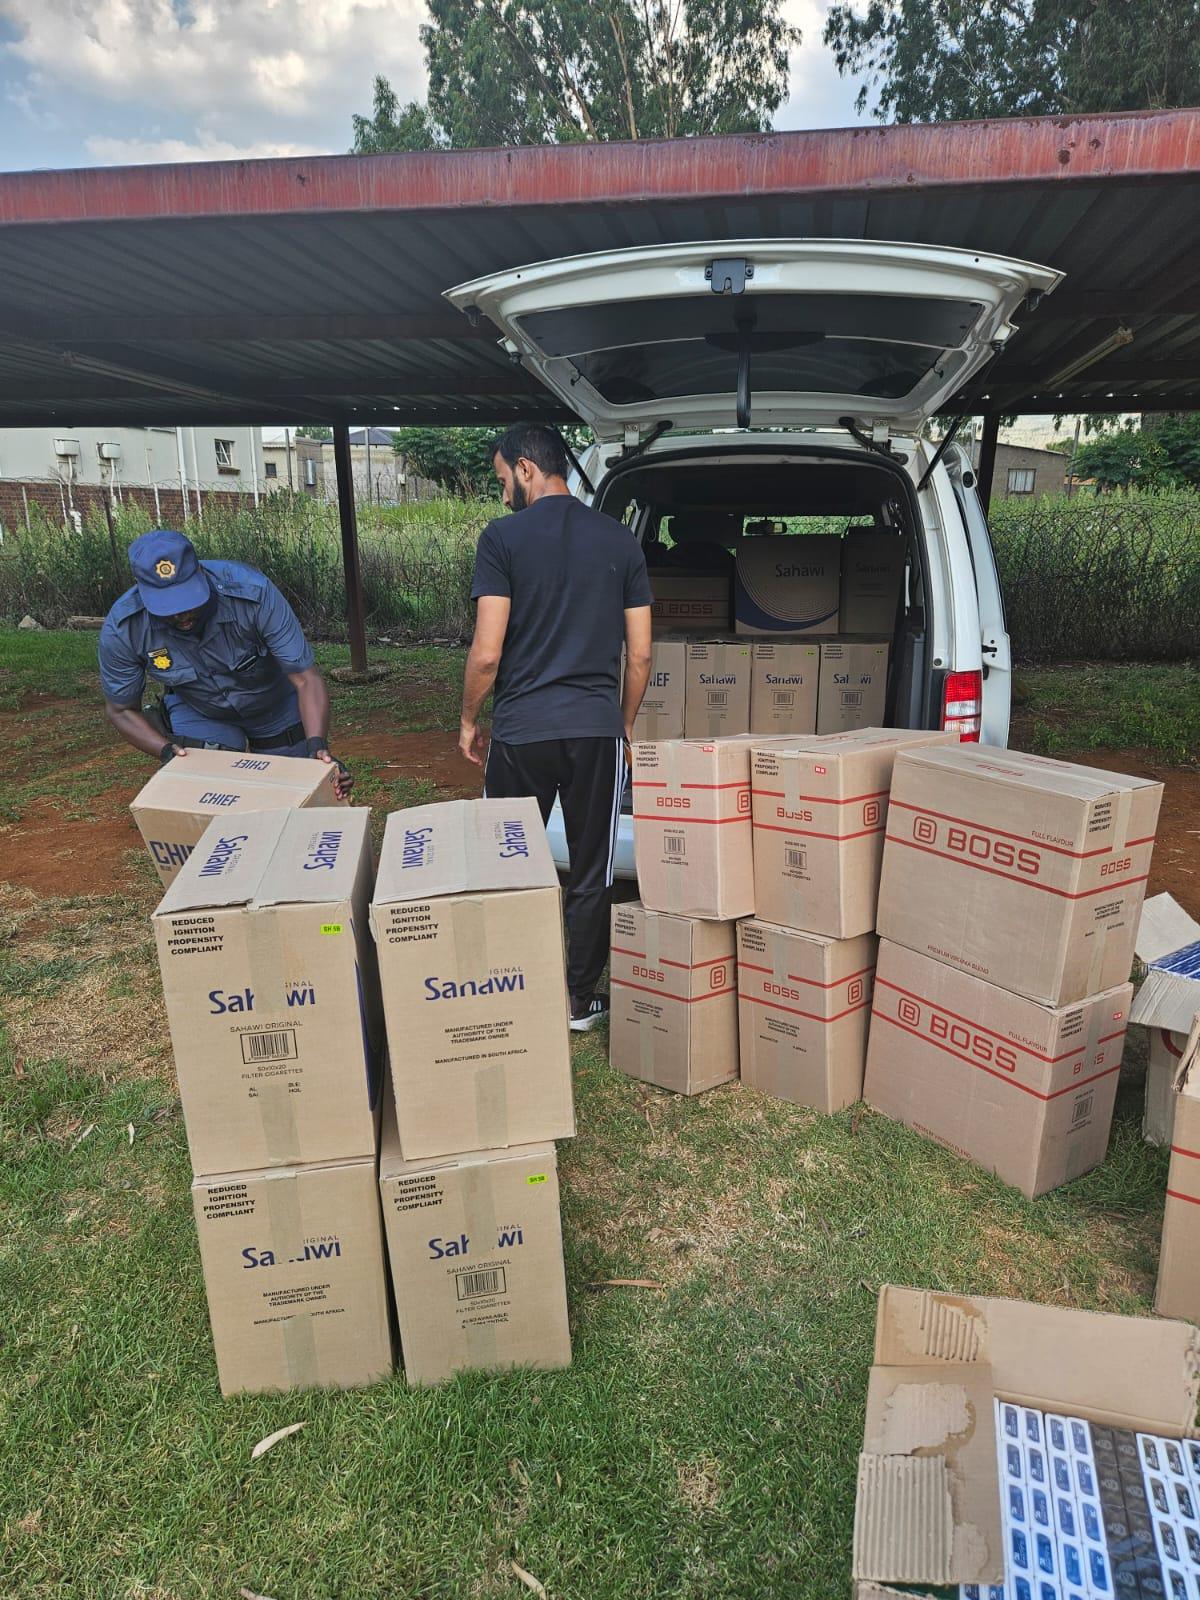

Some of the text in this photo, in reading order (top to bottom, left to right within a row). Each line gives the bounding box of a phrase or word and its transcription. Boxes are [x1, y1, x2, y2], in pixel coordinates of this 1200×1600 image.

[775, 563, 825, 578] Sahawi
[231, 758, 271, 771] CHIEF
[198, 792, 240, 807] CHIEF
[656, 797, 691, 808] BOSS
[499, 820, 529, 858] Sahawi
[304, 831, 343, 870] Sahawi
[402, 827, 433, 869] Sahawi
[947, 827, 1041, 875] BOSS
[198, 835, 248, 877] Sahawi
[1100, 858, 1131, 876] BOSS
[390, 905, 431, 915] REDUCED
[171, 917, 215, 927] REDUCED
[392, 915, 431, 925] IGNITION
[173, 926, 215, 936] IGNITION
[386, 923, 439, 935] PROPENSITY
[167, 935, 224, 946] PROPENSITY
[389, 932, 438, 944] COMPLIANT
[171, 944, 224, 955] COMPLIANT
[489, 966, 523, 975] IGINAL
[632, 965, 665, 982] BOSS
[763, 982, 800, 1000] BOSS
[230, 1020, 303, 1033] SAHAWI ORIGINAL
[444, 1020, 513, 1033] MANUFACTURED UNDER
[450, 1036, 487, 1044] TRADEMARK
[452, 1030, 485, 1038] AUTHORITY
[930, 1014, 1017, 1073] BOSS
[434, 1054, 480, 1064] MANUFACTURED
[264, 1068, 303, 1077] CIGARETTES
[398, 1175, 436, 1186] REDUCED
[207, 1184, 247, 1194] REDUCED
[400, 1184, 436, 1194] IGNITION
[209, 1192, 248, 1202] IGNITION
[394, 1190, 444, 1204] PROPENSITY
[203, 1200, 255, 1212] PROPENSITY
[397, 1199, 443, 1212] COMPLIANT
[206, 1208, 255, 1220] COMPLIANT
[305, 1235, 339, 1243] IGINAL
[446, 1259, 512, 1275] SAHAWI ORIGINAL
[263, 1283, 331, 1297] MANUFACTURED UNDER
[269, 1294, 327, 1307] TRADEMARK OWNER
[271, 1293, 303, 1302] AUTHORITY
